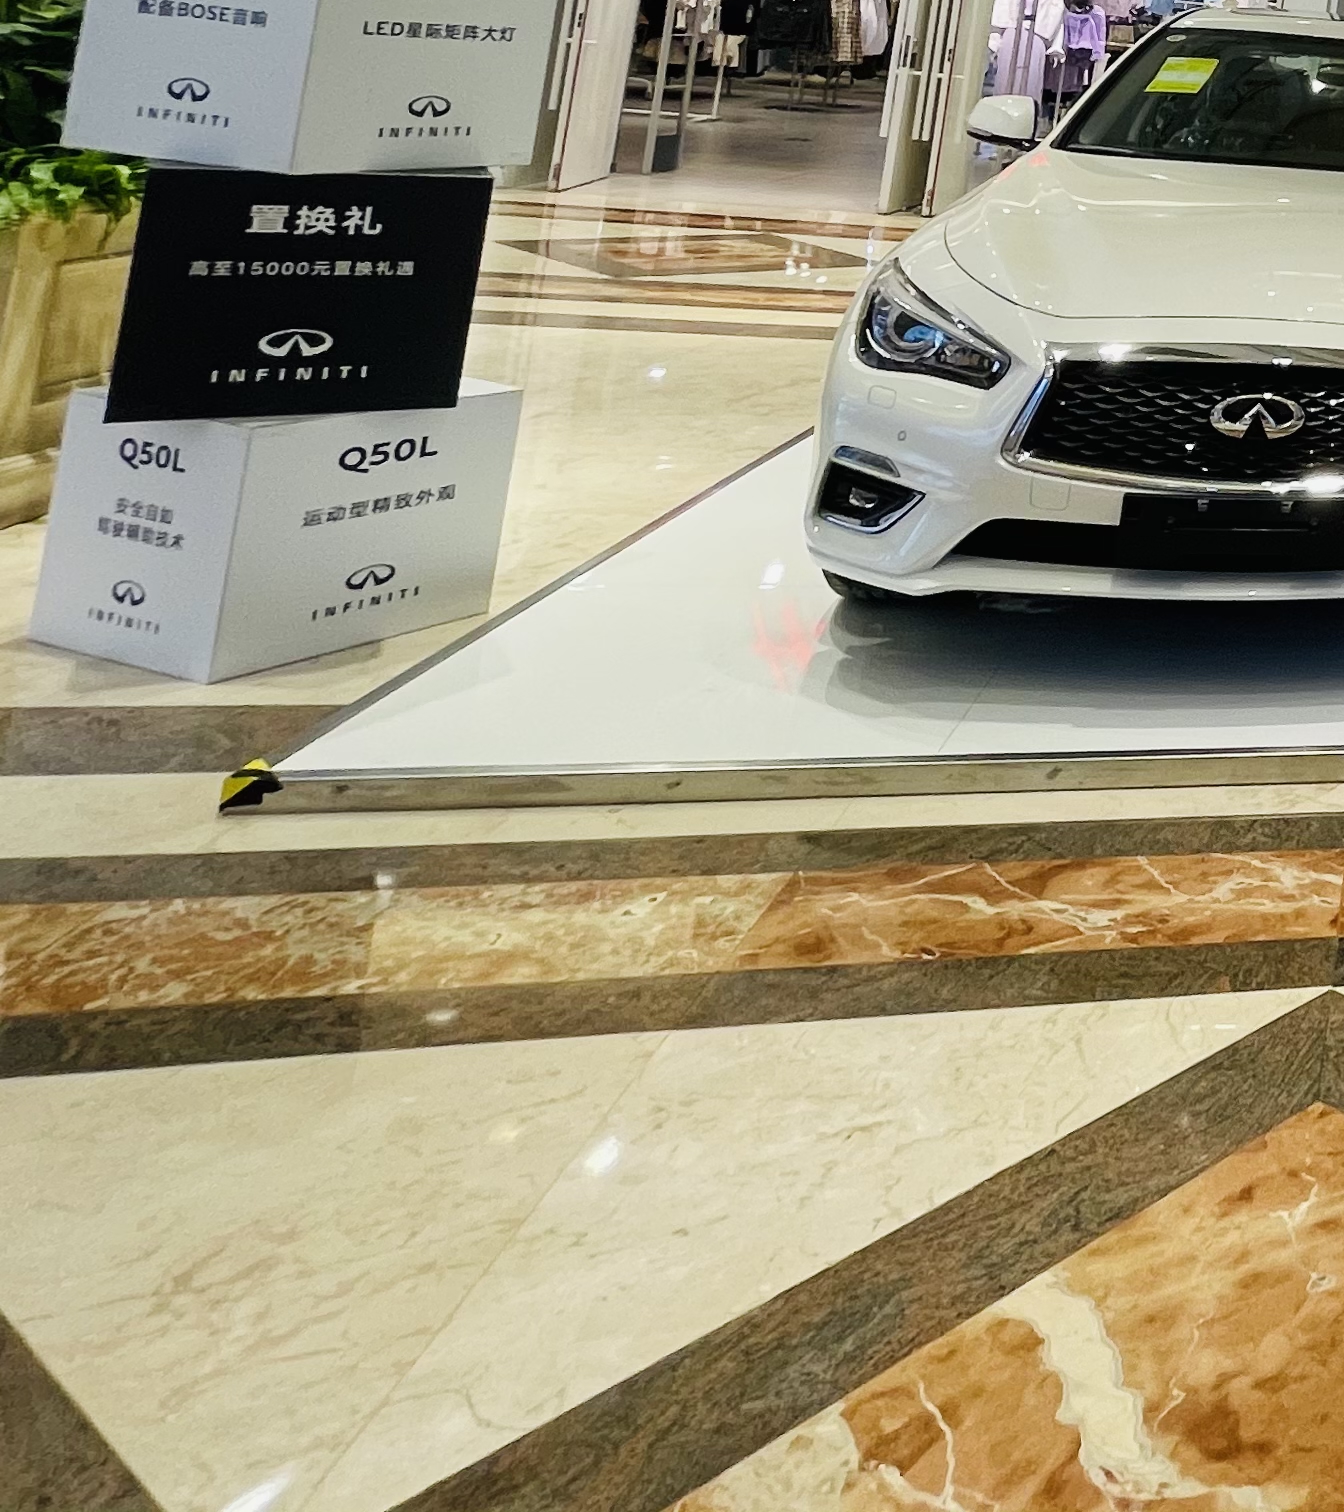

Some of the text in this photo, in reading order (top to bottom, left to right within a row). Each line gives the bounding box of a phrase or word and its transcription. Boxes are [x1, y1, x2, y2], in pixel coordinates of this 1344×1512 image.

[136, 105, 230, 129] INFINITI
[377, 126, 471, 139] INFINITI
[244, 204, 383, 236] 置换礼
[208, 365, 369, 384] INFINITI
[119, 437, 186, 473] Q50L
[338, 435, 439, 474] Q50L
[301, 484, 456, 528] 运动型精致外观
[311, 584, 421, 622] INFINITI
[88, 607, 161, 636] INFINITI
